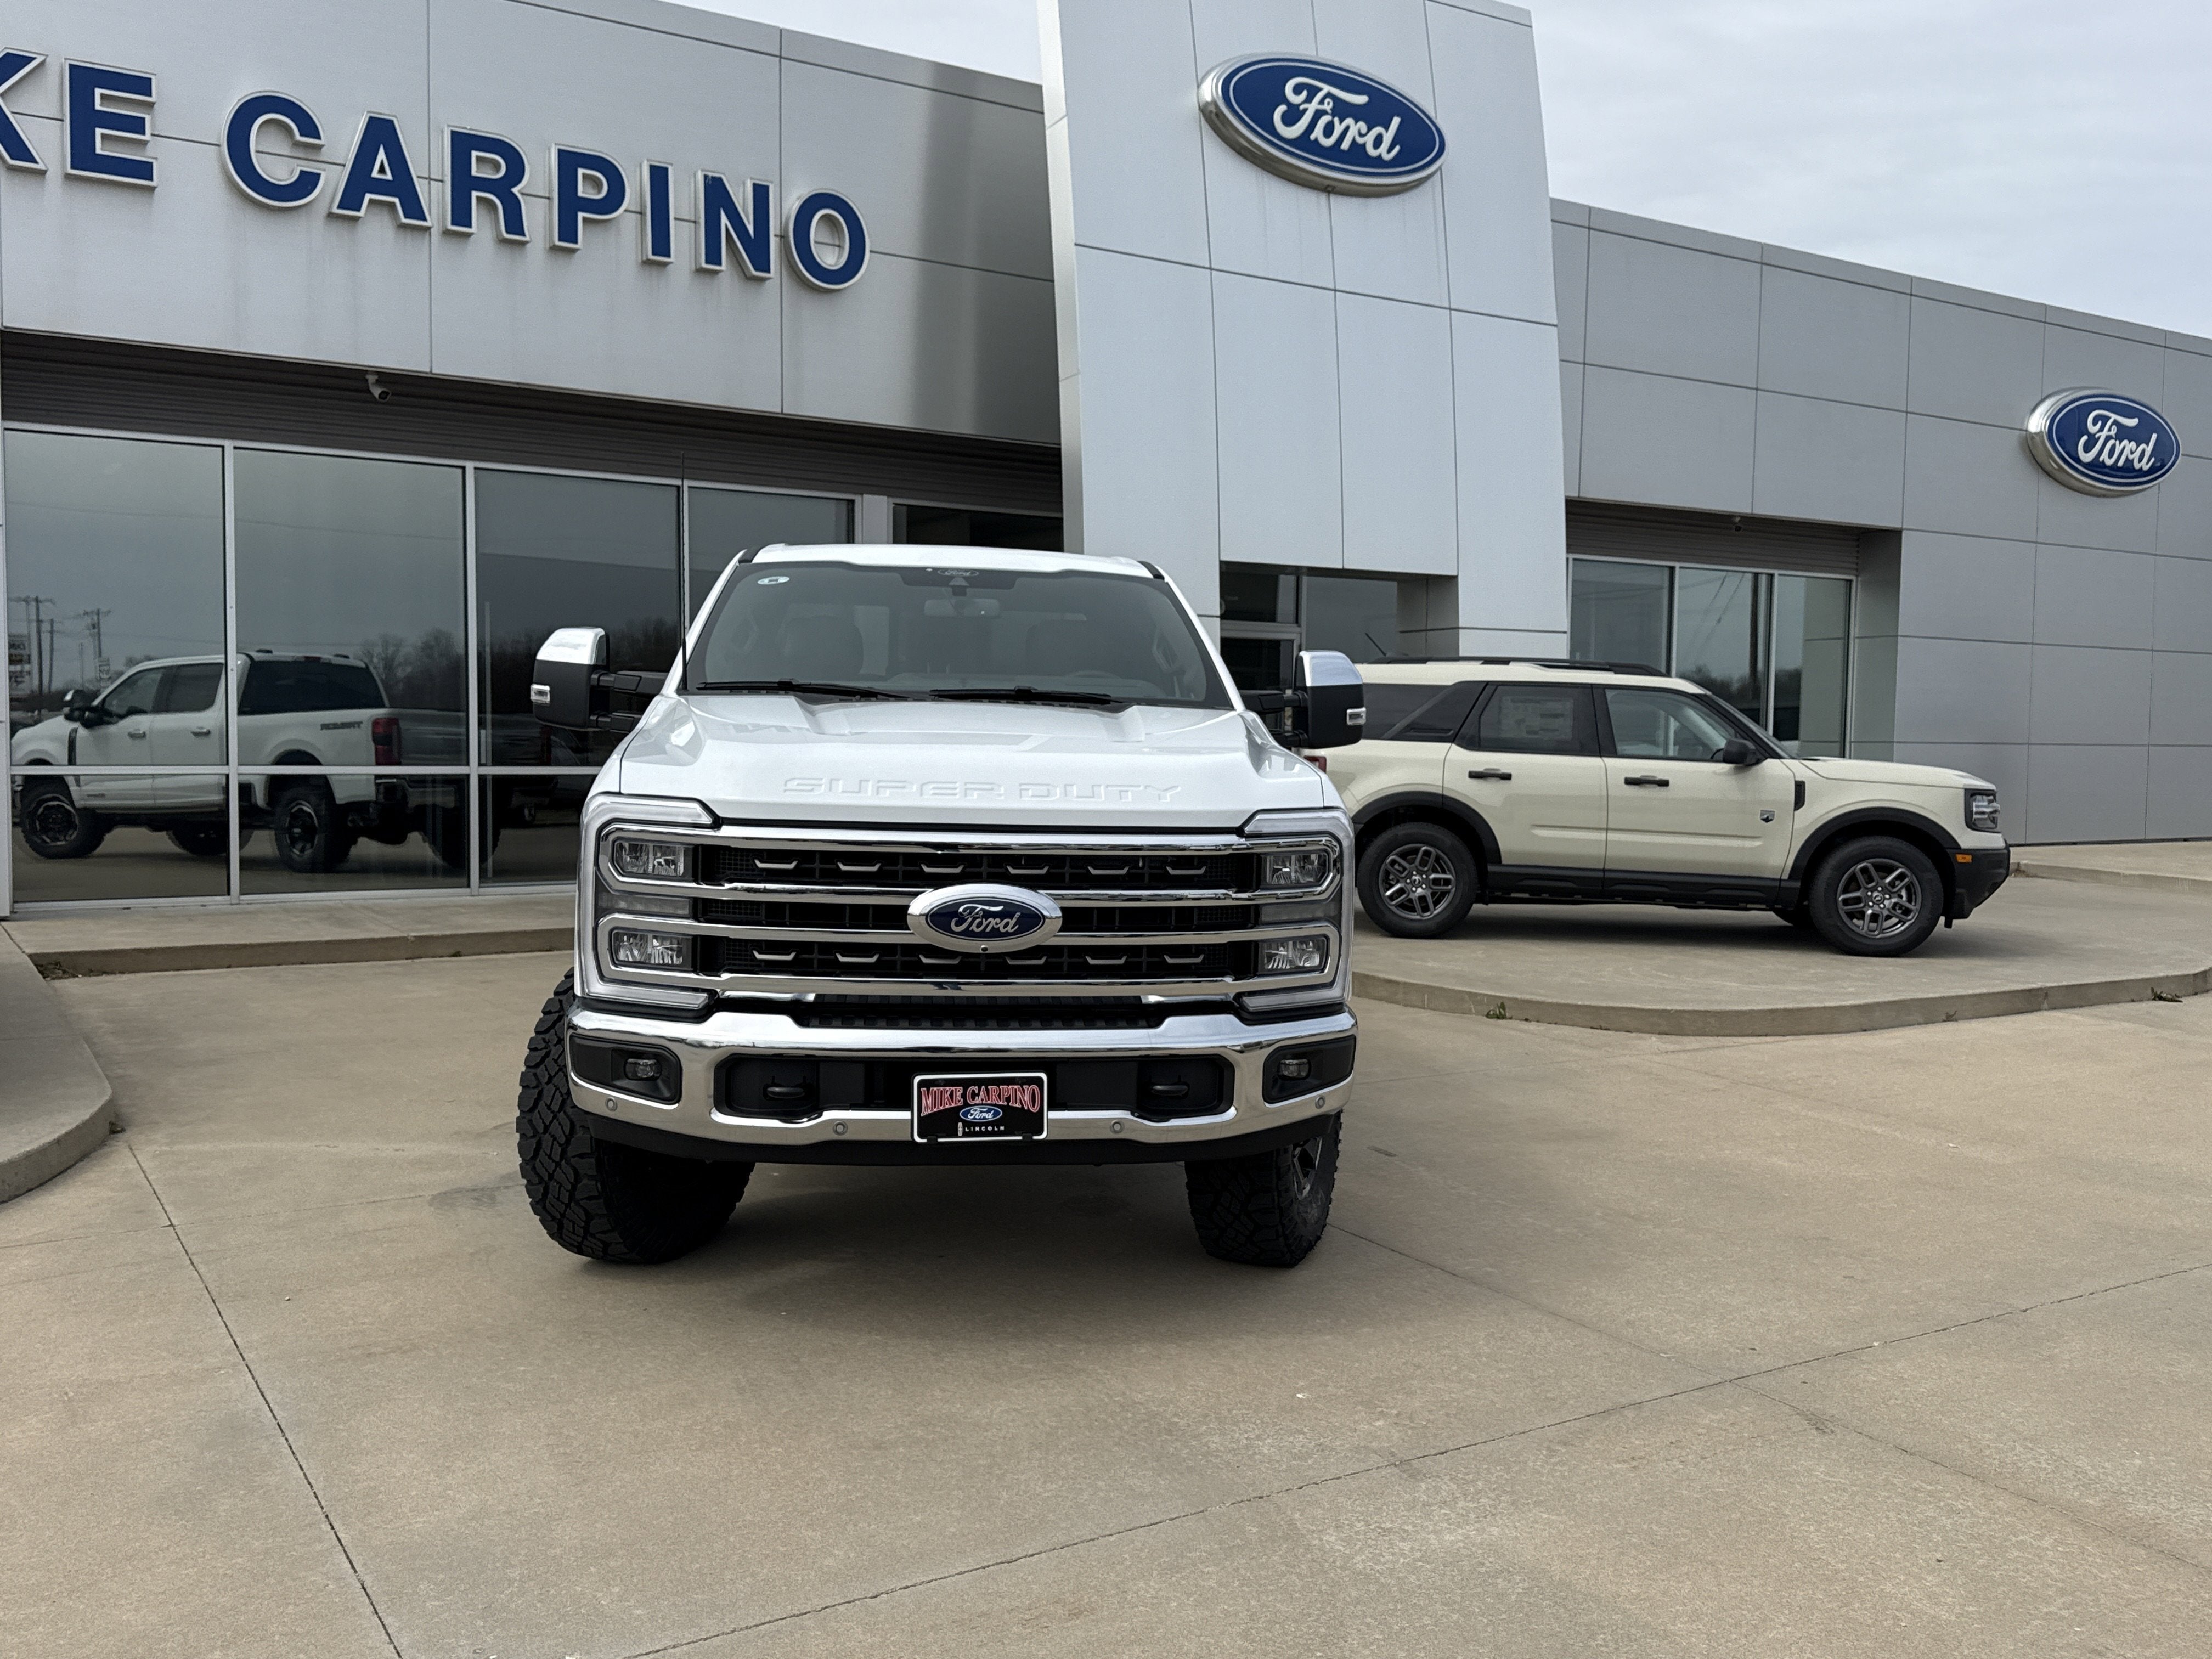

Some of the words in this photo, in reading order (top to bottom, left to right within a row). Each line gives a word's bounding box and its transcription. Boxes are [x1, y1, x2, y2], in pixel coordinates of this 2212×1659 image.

[1273, 76, 1402, 162] Ford
[221, 90, 871, 291] CARPINO
[2078, 409, 2158, 471] Ford
[783, 777, 1005, 800] SUPER
[1018, 783, 1181, 802] DUTY
[950, 904, 1021, 933] Ford
[920, 1087, 963, 1117] MIKE
[966, 1084, 1041, 1113] CARPINO
[967, 1107, 994, 1120] Ford
